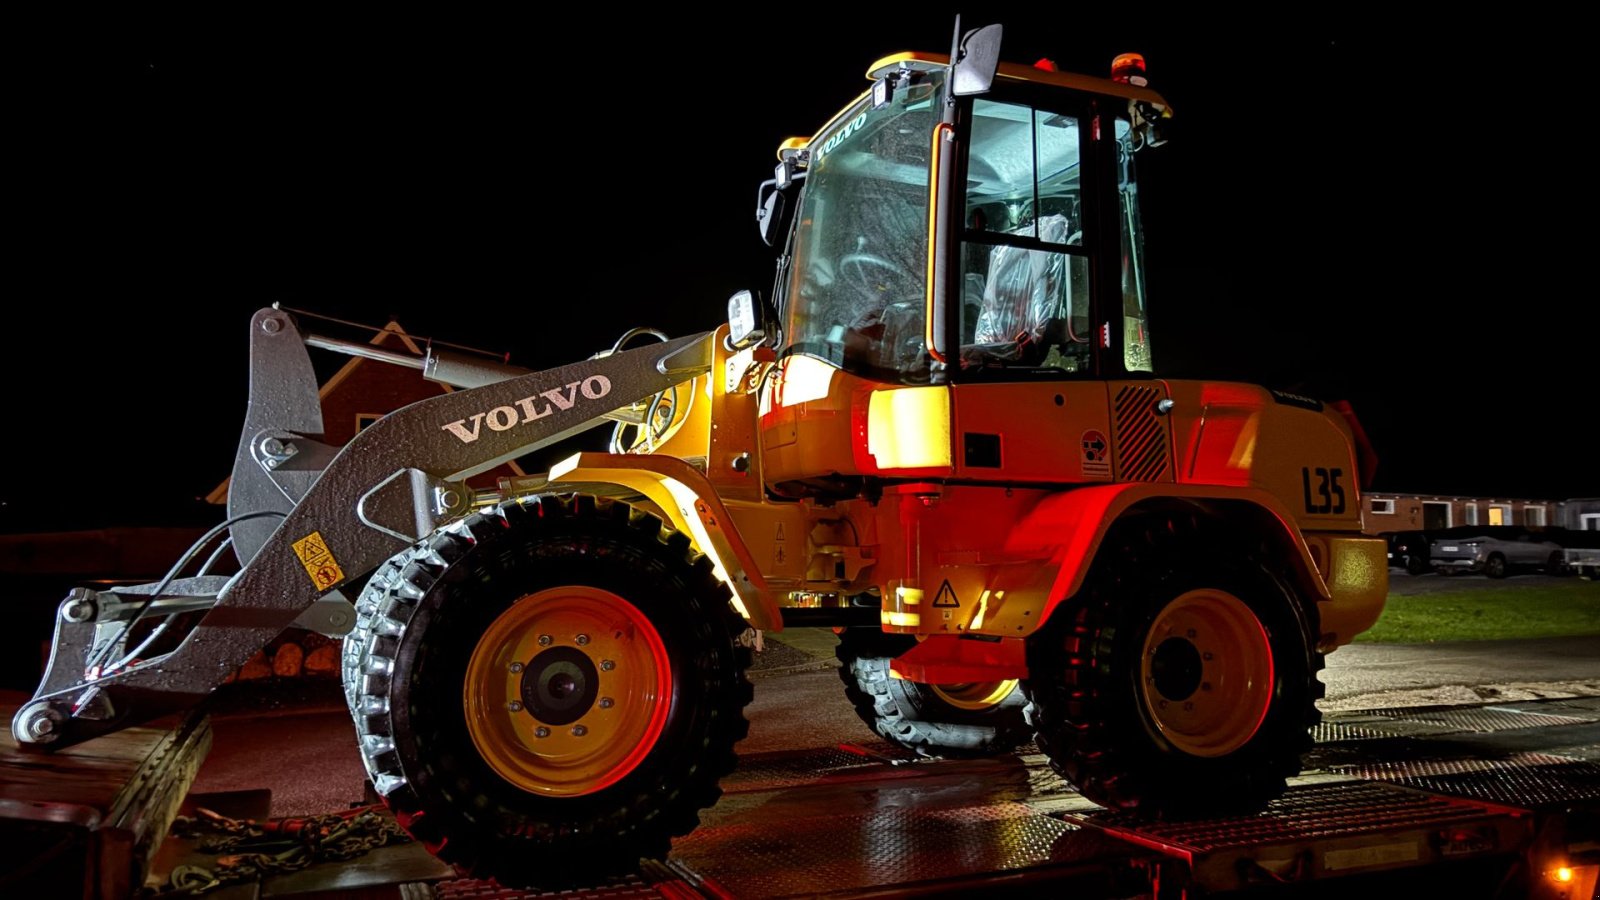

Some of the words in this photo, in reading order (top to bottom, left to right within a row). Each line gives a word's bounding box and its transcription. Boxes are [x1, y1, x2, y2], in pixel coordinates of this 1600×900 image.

[816, 112, 867, 161] VOLVO
[441, 374, 612, 444] VOLVO
[1302, 466, 1345, 514] L35
